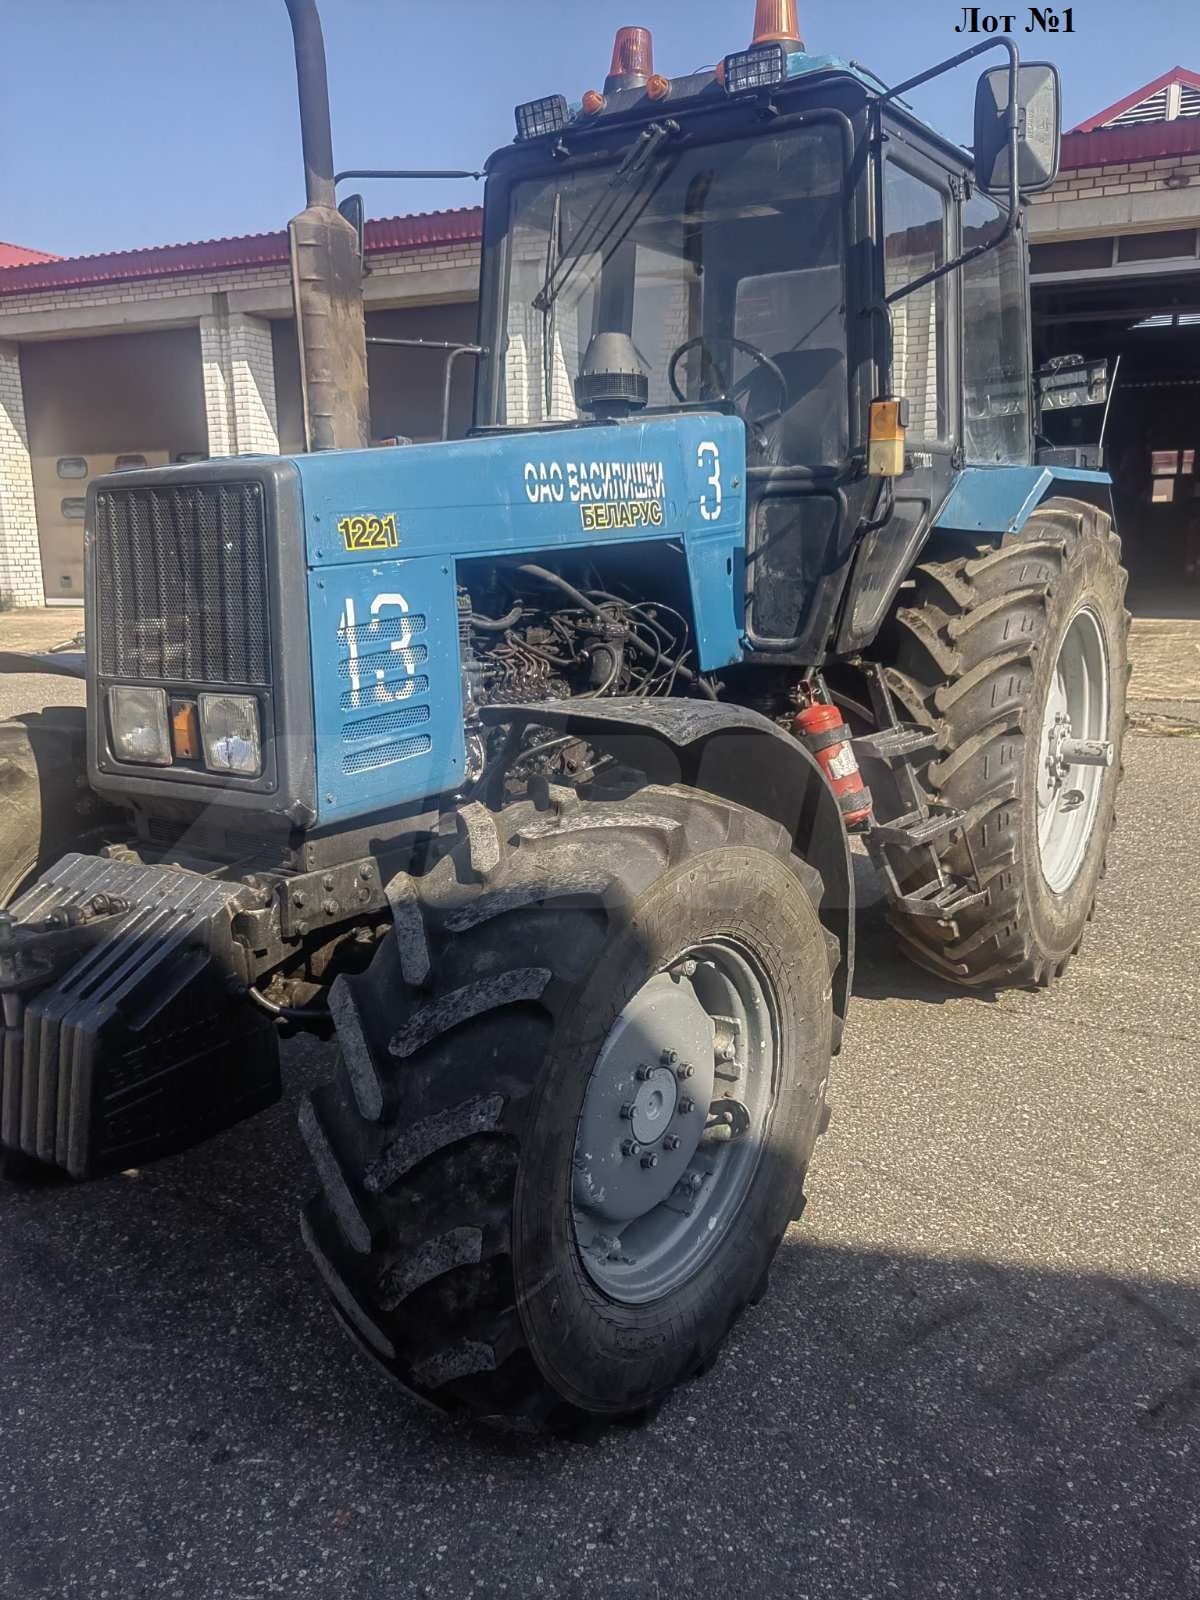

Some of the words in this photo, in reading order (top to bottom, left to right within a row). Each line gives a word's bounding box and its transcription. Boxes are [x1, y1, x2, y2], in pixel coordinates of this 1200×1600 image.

[524, 462, 564, 503] ОАО
[567, 462, 665, 502] ВАСИЛИШКИ
[697, 441, 722, 520] 3
[338, 515, 399, 551] 1221
[580, 499, 663, 531] БЕЛАРУС
[336, 593, 416, 710] 13
